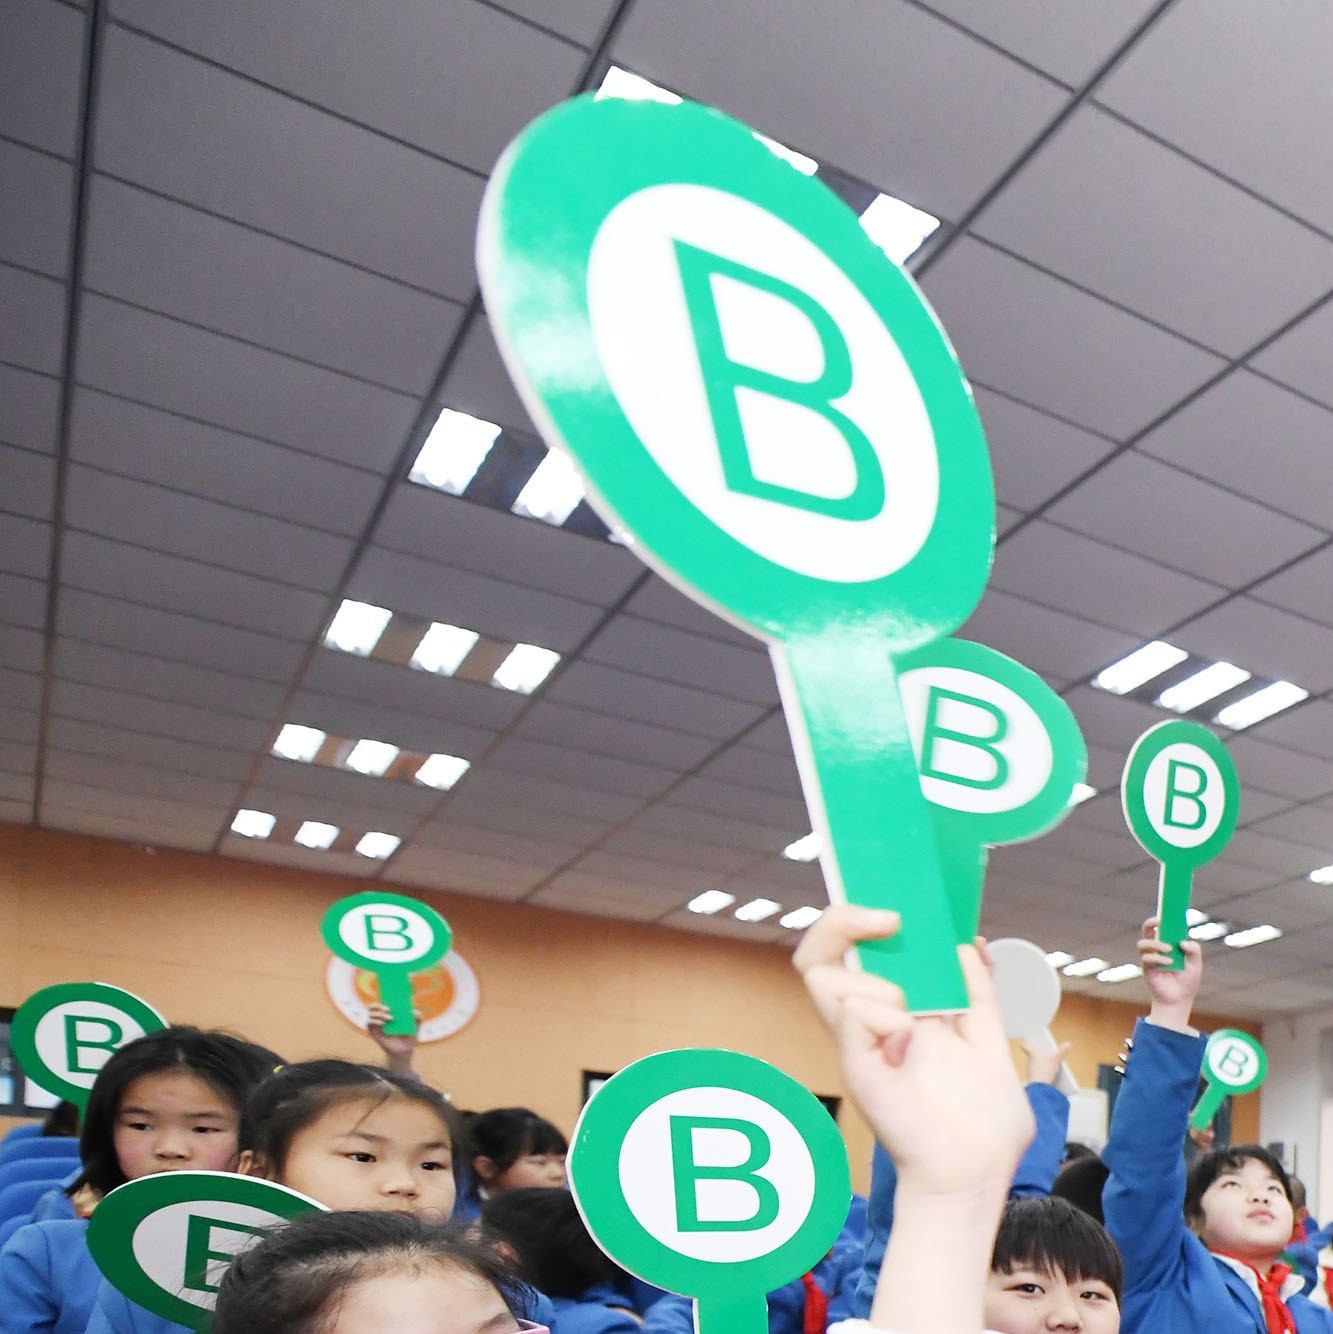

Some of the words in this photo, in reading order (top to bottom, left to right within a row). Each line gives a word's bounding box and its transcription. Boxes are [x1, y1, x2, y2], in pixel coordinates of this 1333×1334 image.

[672, 238, 885, 522] B
[920, 686, 1011, 792] B
[1163, 759, 1208, 830] B
[364, 914, 413, 952] B
[64, 1014, 122, 1075] B
[1219, 1045, 1248, 1078] B
[669, 1115, 780, 1233] B
